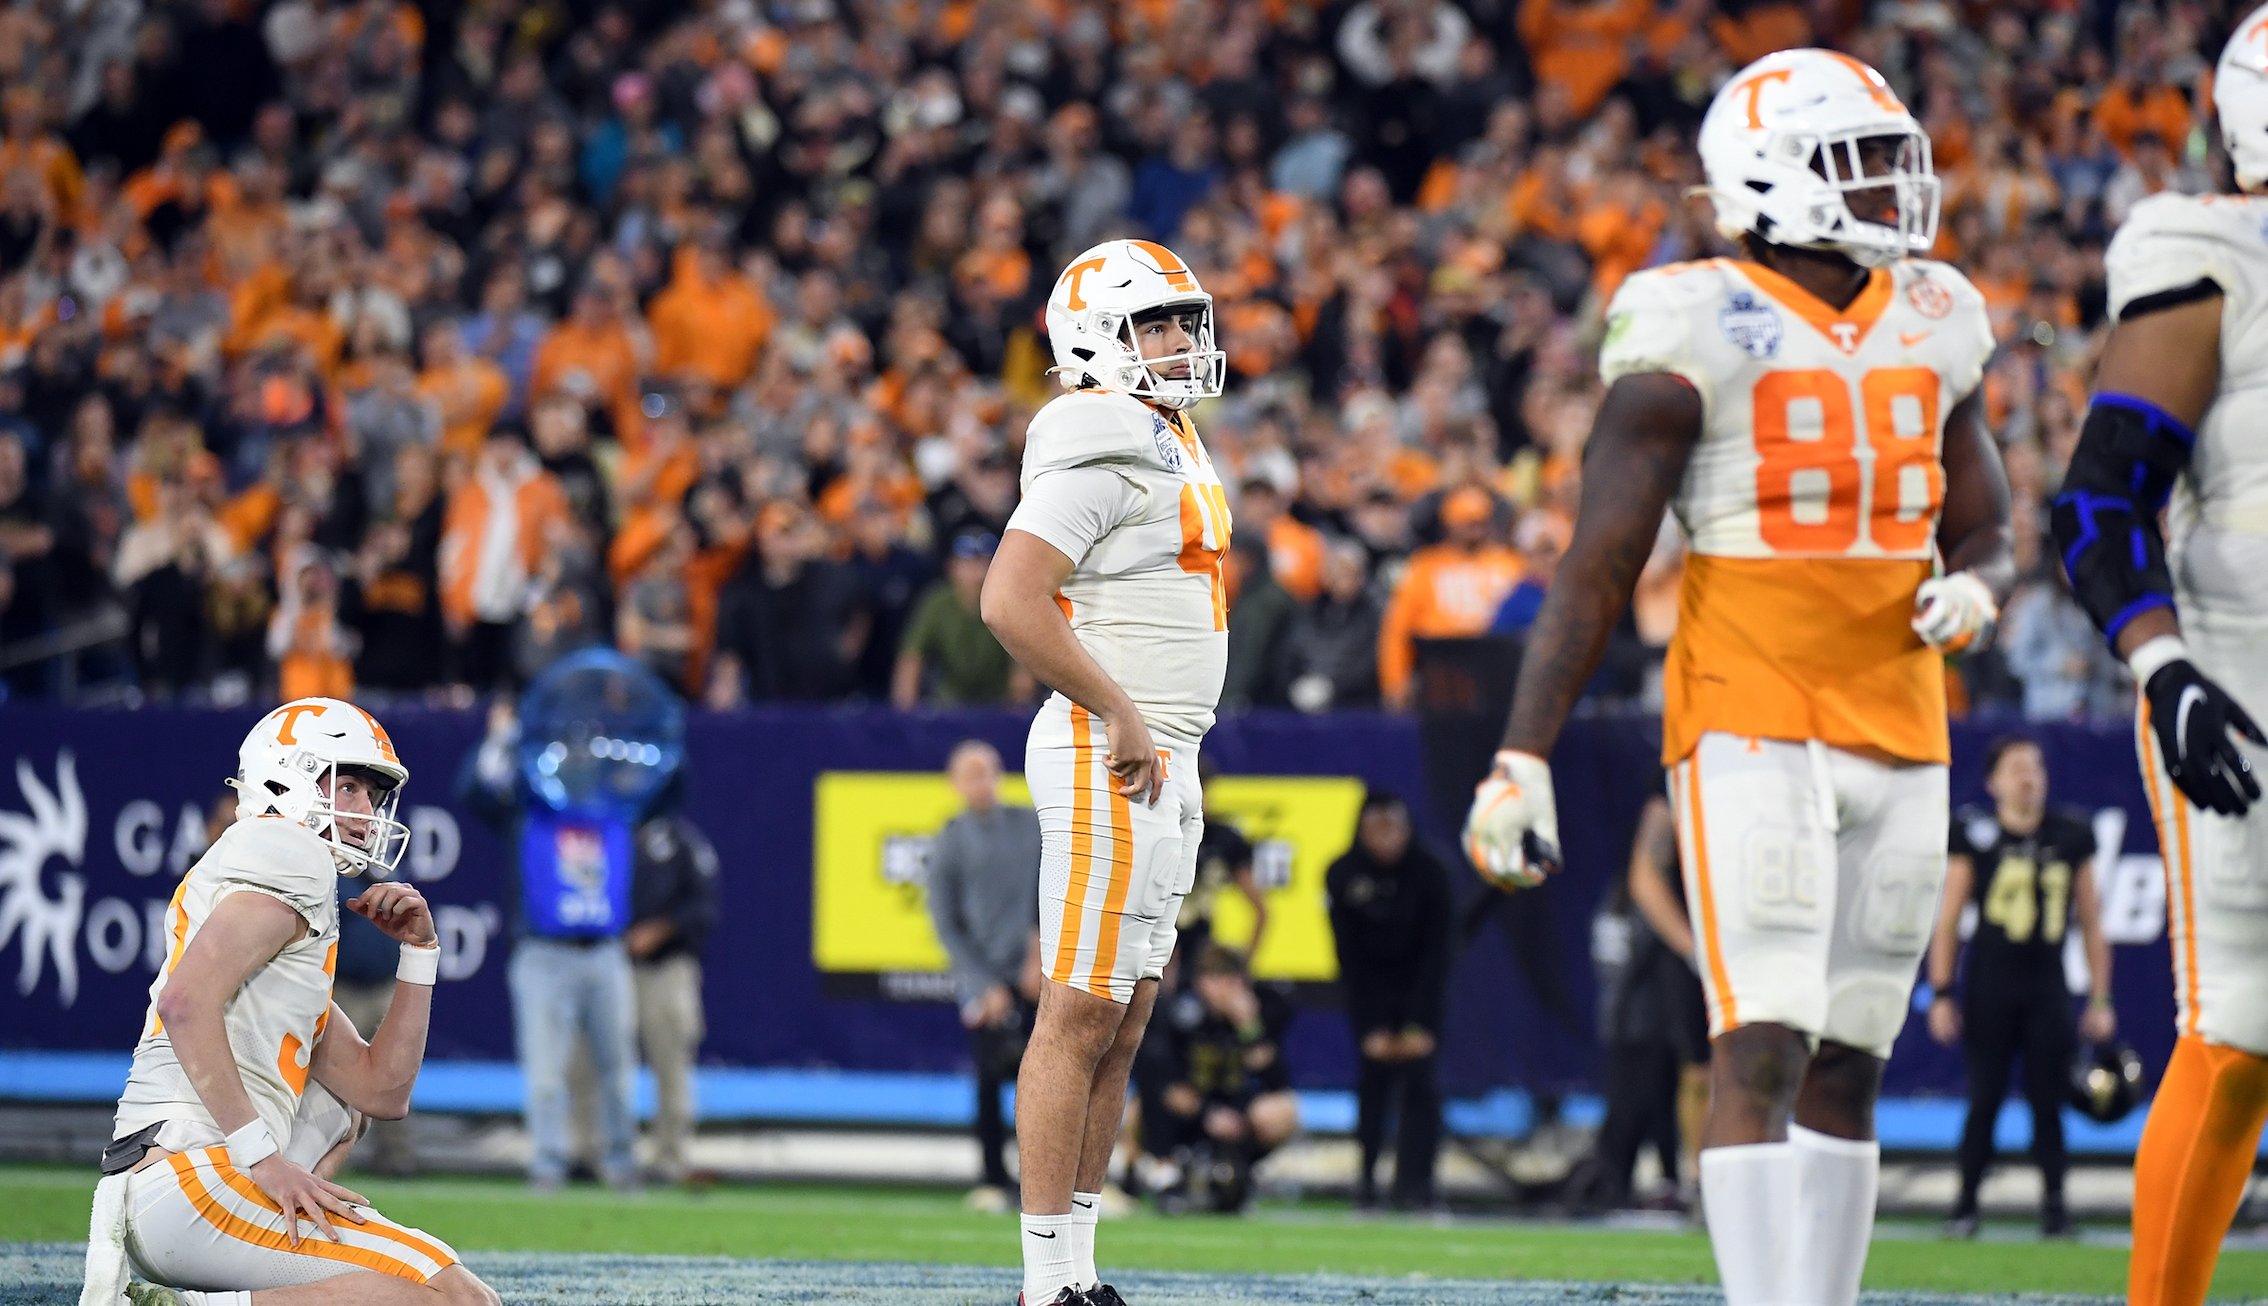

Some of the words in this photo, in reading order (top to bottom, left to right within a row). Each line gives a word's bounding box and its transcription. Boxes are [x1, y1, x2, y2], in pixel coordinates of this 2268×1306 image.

[1734, 69, 1791, 130] T
[1060, 257, 1107, 312] T
[1830, 323, 1859, 354] T
[1753, 367, 1942, 553] 88
[271, 705, 329, 746] T
[1985, 857, 2073, 944] 41
